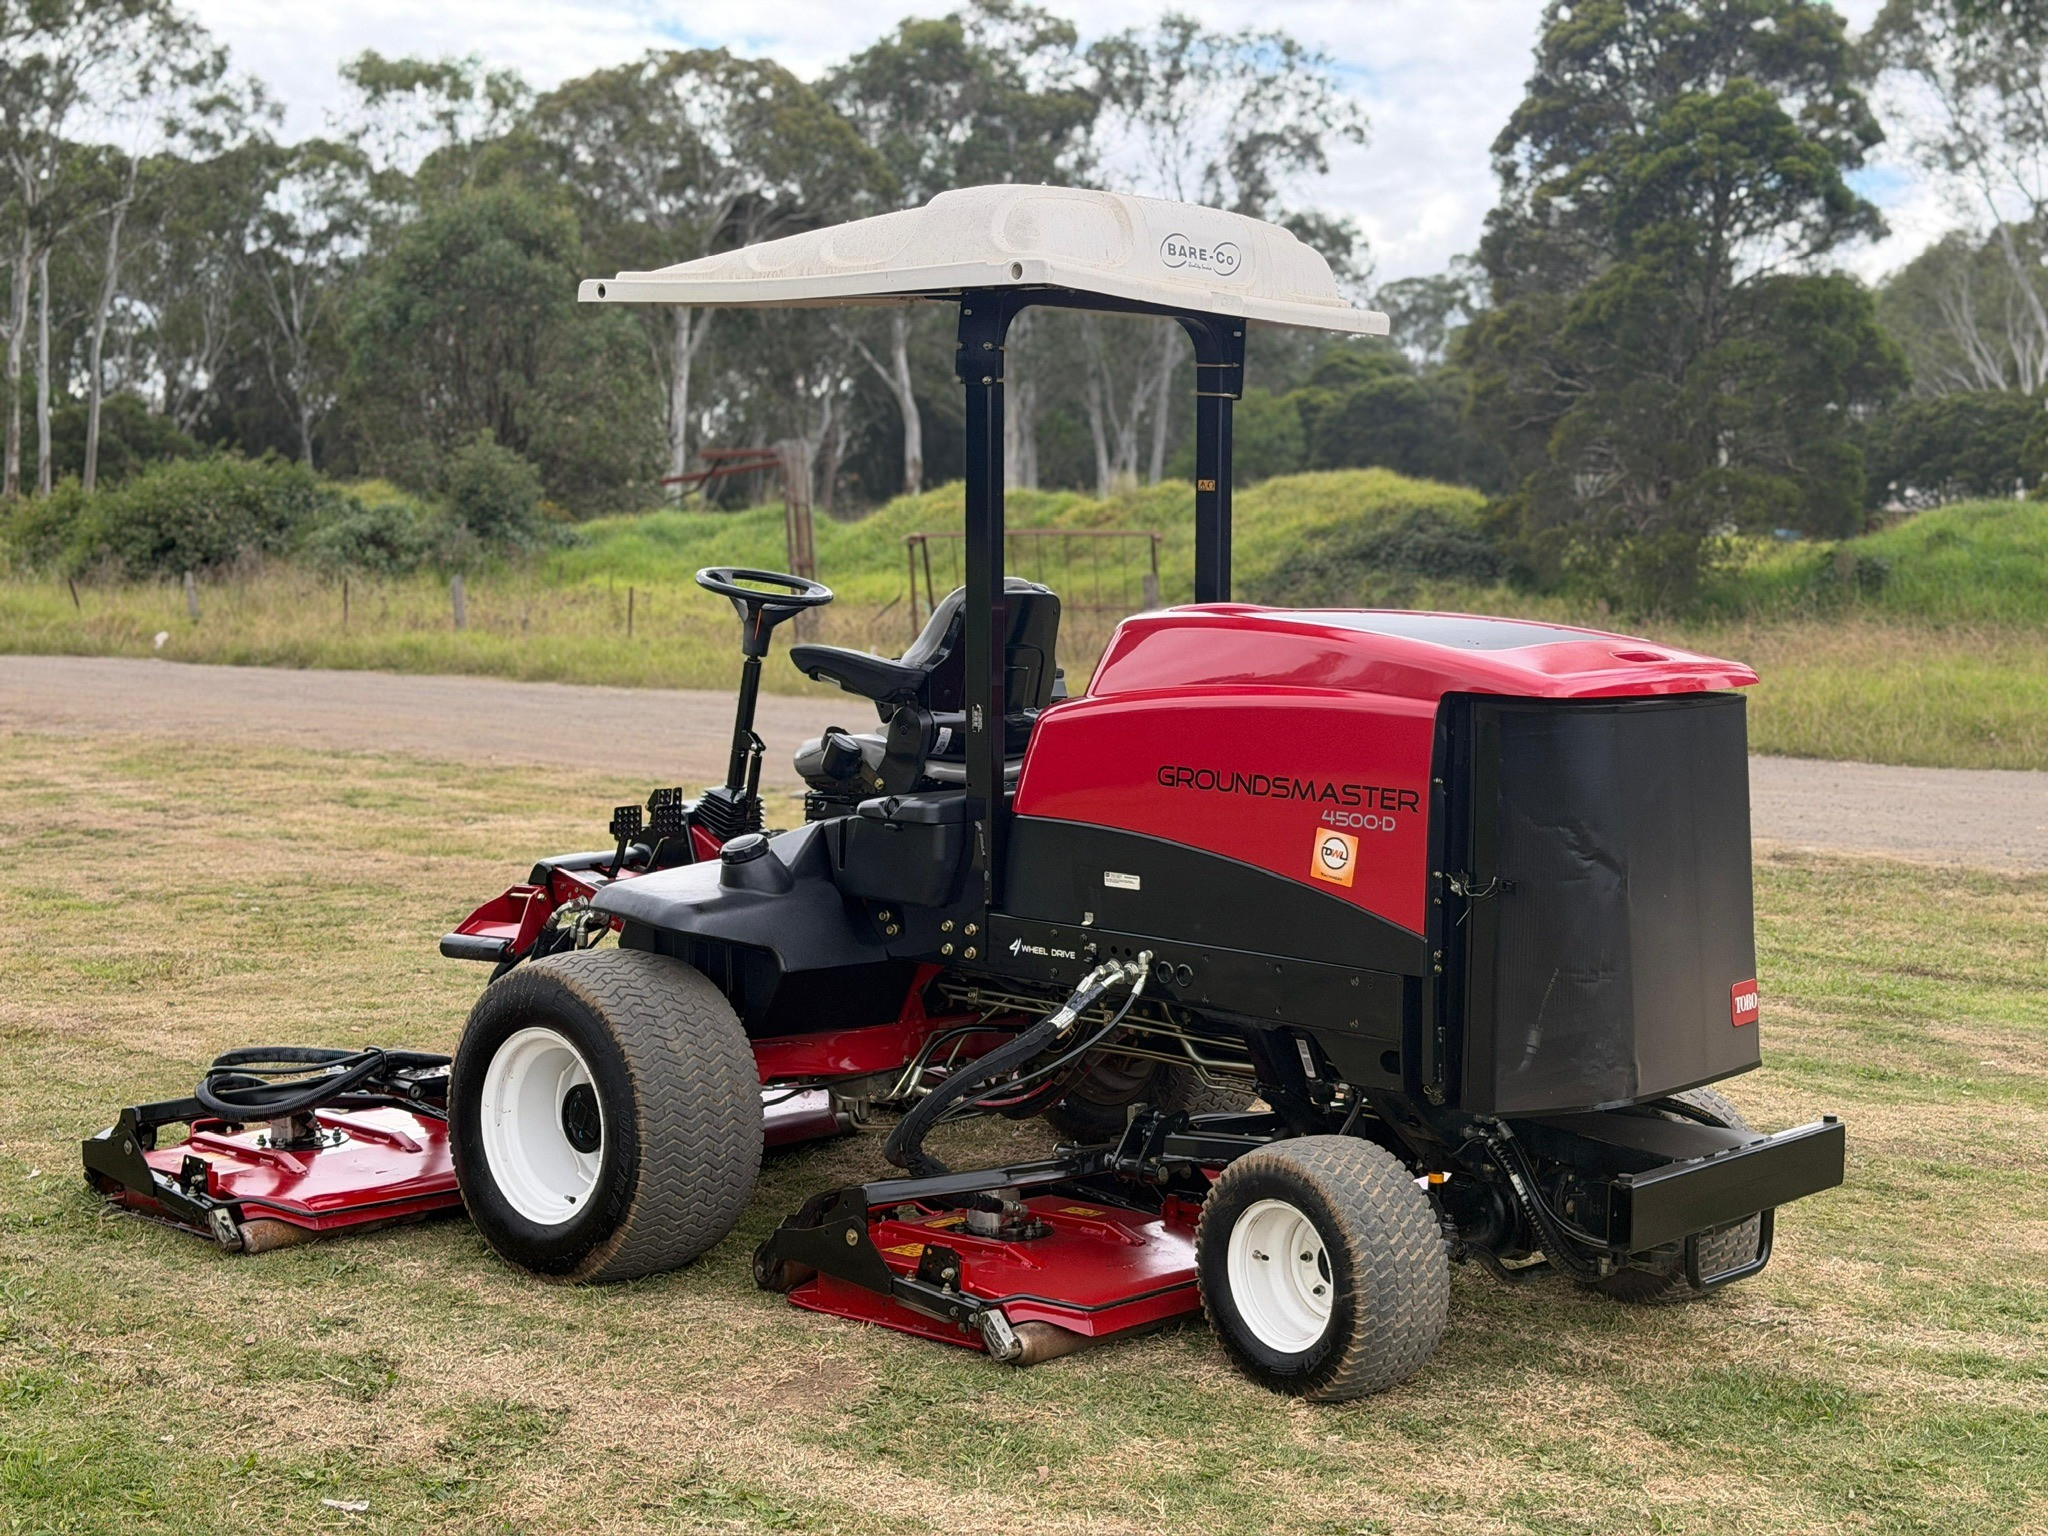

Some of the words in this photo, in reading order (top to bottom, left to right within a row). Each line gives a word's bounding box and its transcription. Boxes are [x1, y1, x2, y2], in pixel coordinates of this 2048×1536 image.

[1157, 765, 1420, 813] GROUNDSMASTER
[1009, 937, 1021, 957] 4
[1021, 944, 1049, 956] WHEEL
[1051, 948, 1076, 960] DRIVE
[1734, 992, 1758, 1014] TORO
